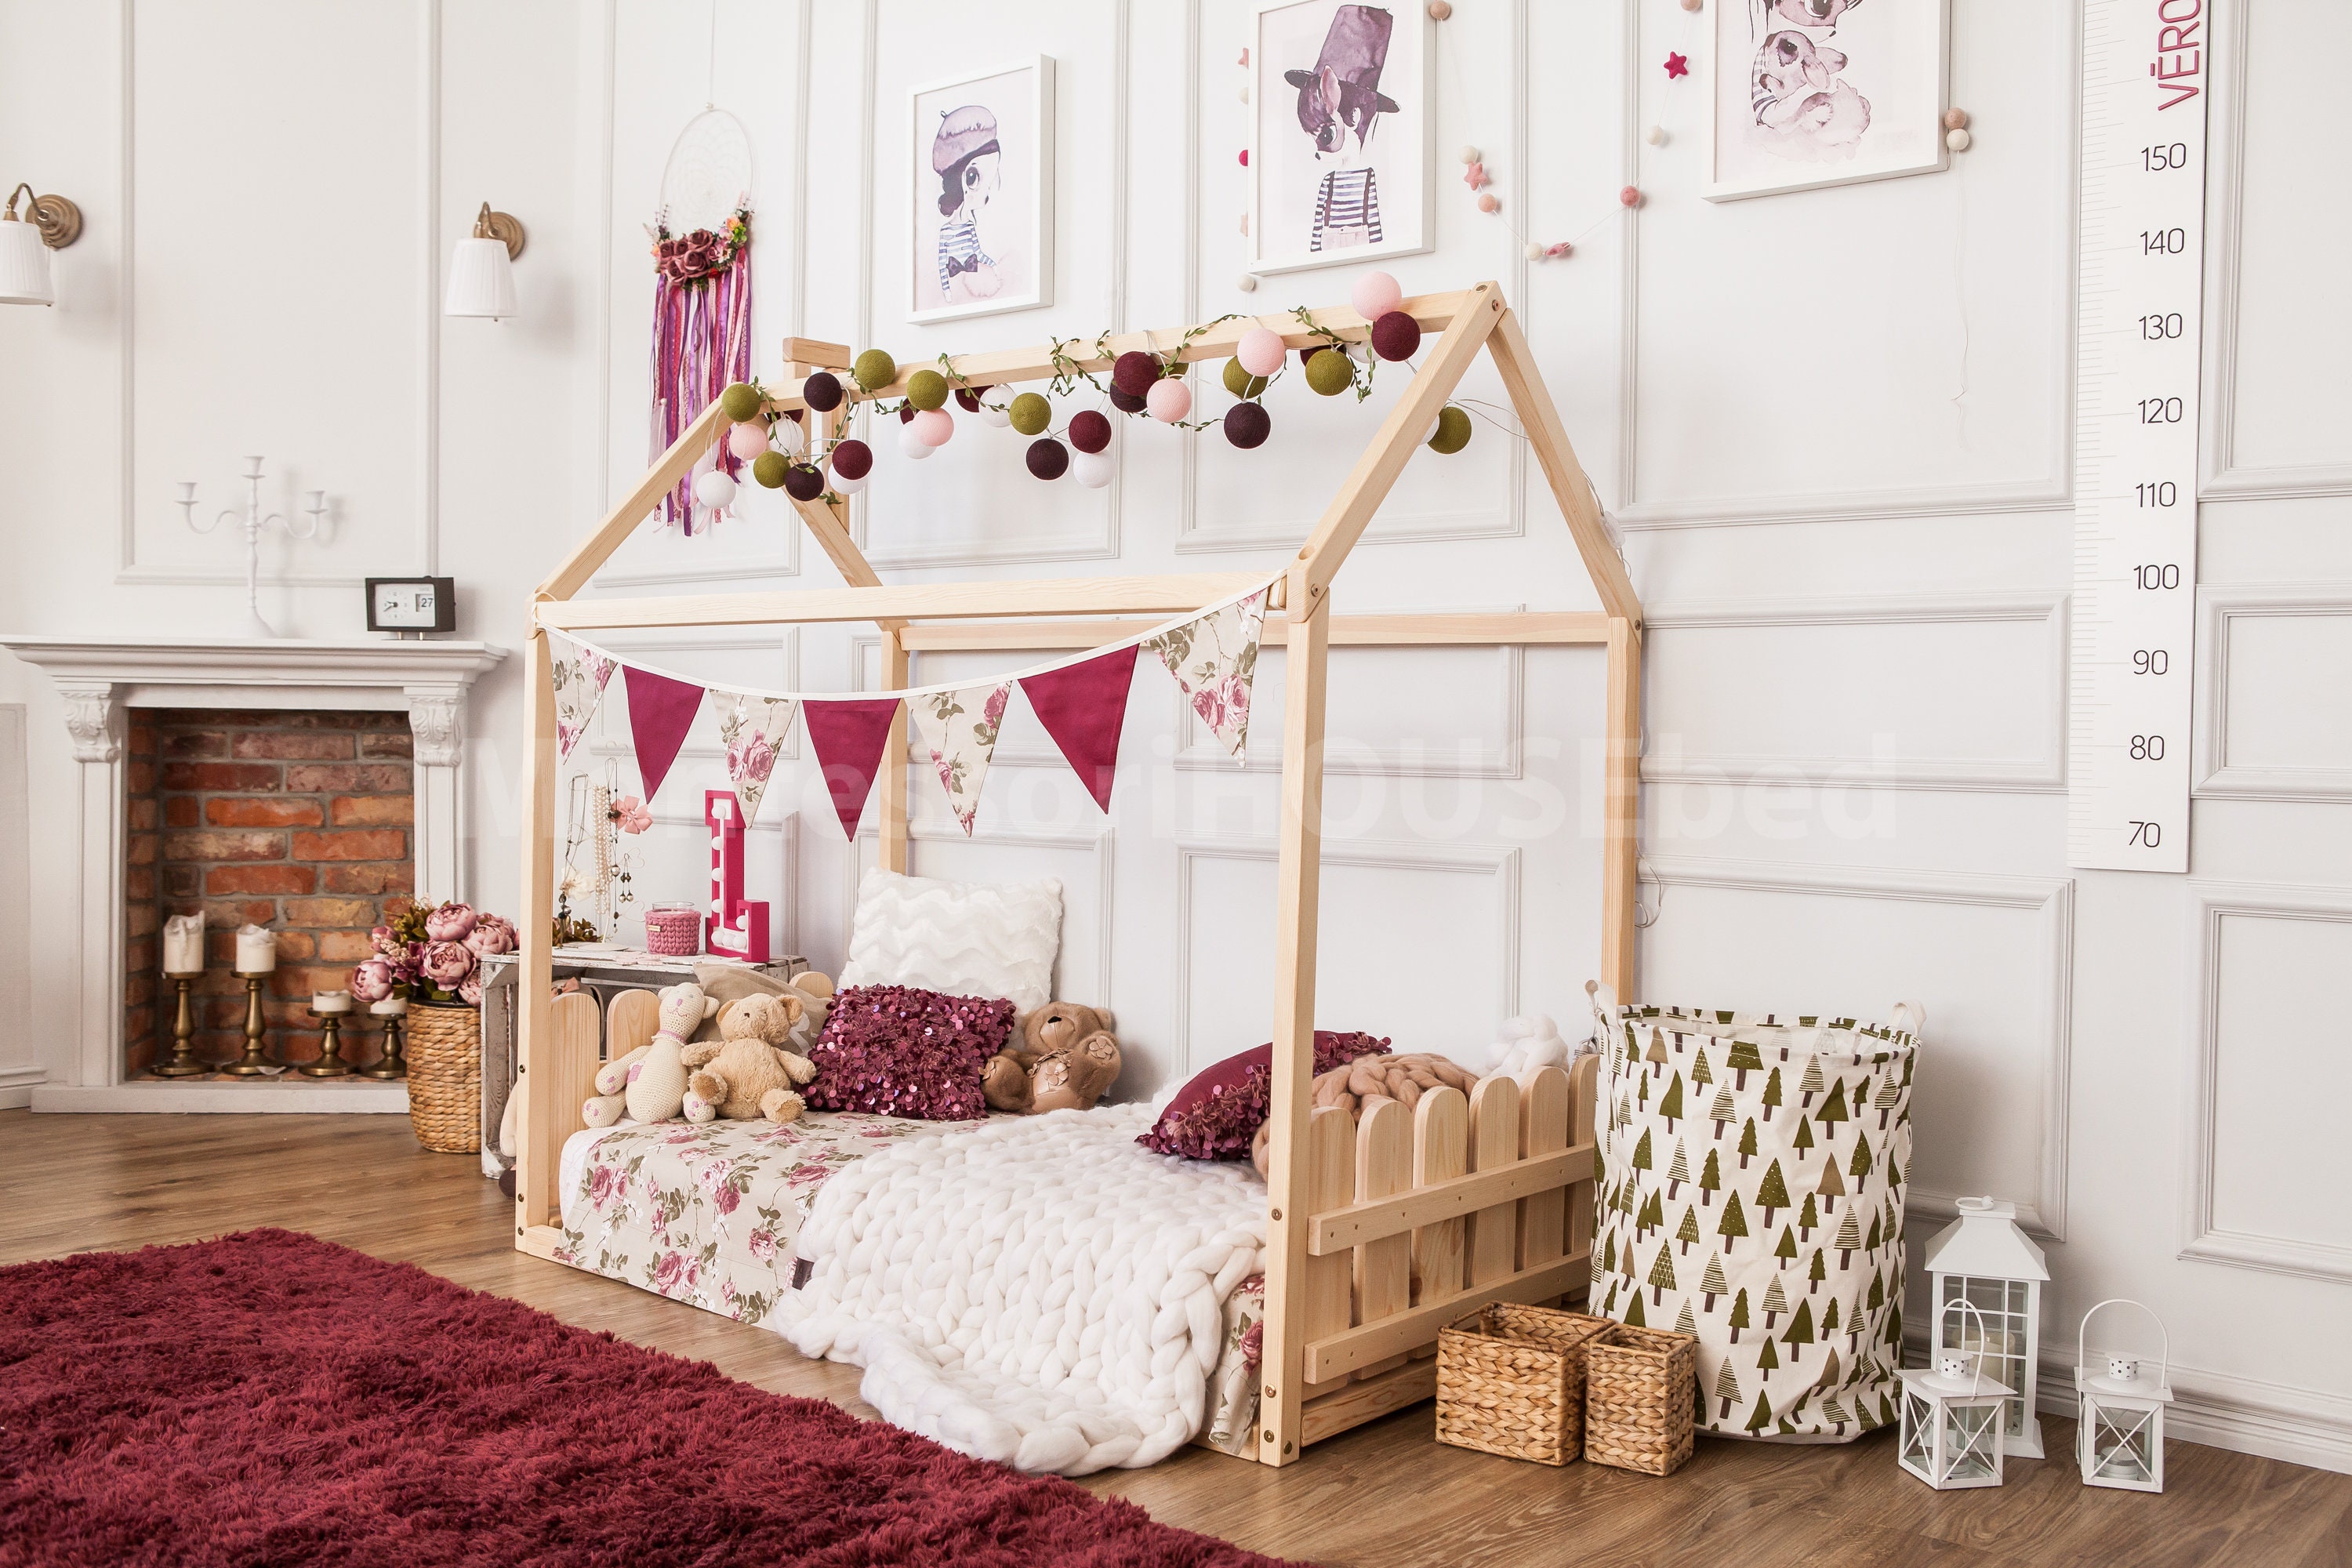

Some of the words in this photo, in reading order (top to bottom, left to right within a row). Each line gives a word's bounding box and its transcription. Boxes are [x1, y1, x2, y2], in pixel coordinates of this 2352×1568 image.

[2141, 143, 2187, 172] 150
[2140, 227, 2185, 256] 140
[2138, 313, 2183, 340] 130
[2138, 397, 2183, 424] 120
[2136, 481, 2176, 508] 110
[2133, 564, 2180, 590] 100
[421, 597, 434, 608] 27
[2133, 649, 2169, 675] 90
[2129, 735, 2165, 761] 80
[2129, 821, 2161, 848] 70
